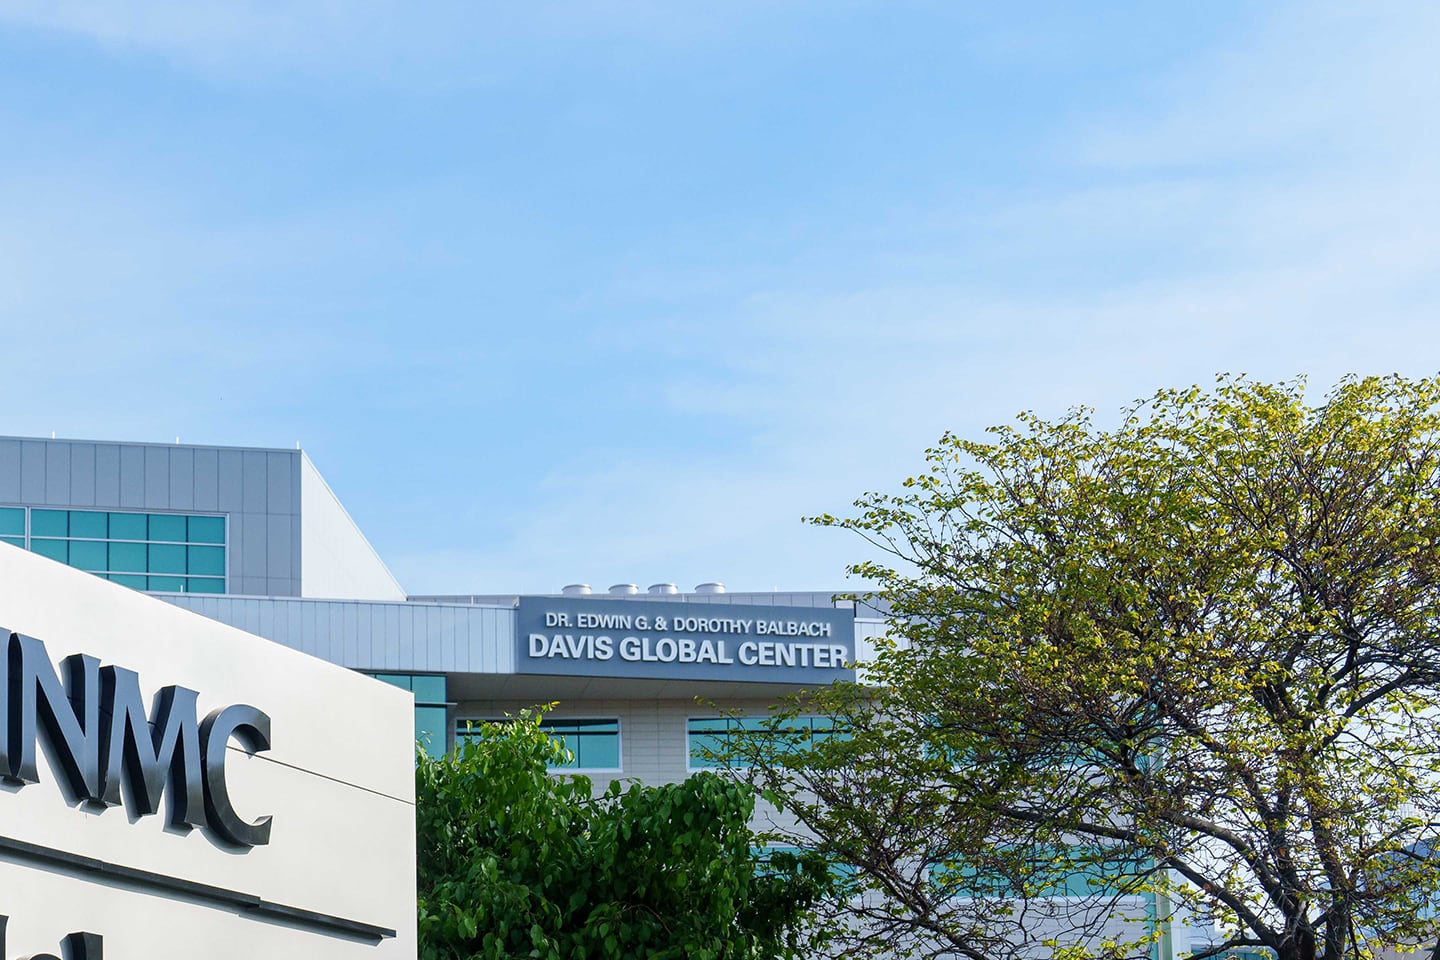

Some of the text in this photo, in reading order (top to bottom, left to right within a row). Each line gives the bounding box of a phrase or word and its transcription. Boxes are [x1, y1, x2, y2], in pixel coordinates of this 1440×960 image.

[545, 612, 831, 637] DR. EDWIN G. & DOROTHY BALBACH
[528, 633, 848, 668] DAVIS GLOBAL CENTER
